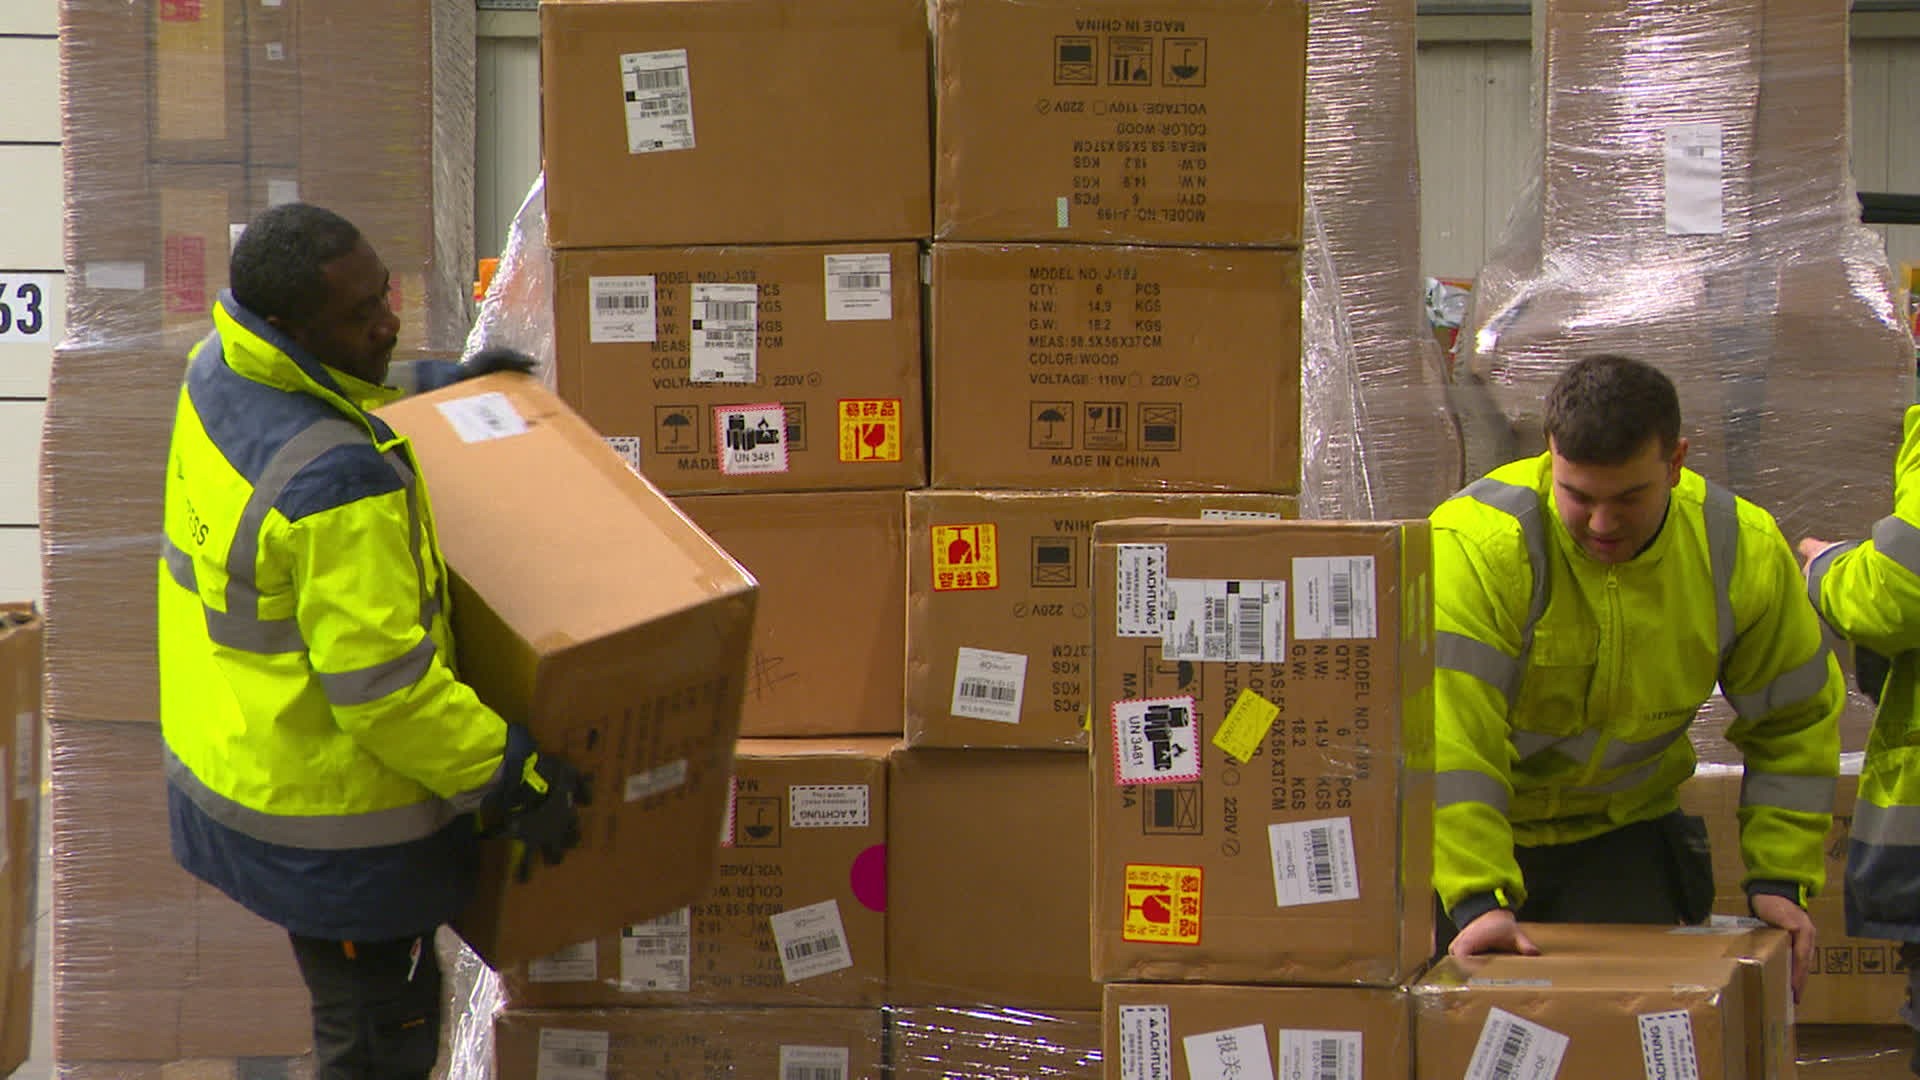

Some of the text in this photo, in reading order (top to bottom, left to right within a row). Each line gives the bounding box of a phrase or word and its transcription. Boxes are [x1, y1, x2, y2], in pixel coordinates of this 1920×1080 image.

[1076, 20, 1185, 32] MADE IN CHINA
[1073, 157, 1100, 168] KGS
[1073, 176, 1100, 188] KGS
[1074, 193, 1100, 205] PCS
[1162, 208, 1206, 222] MODEL
[1029, 267, 1073, 280] MODEL
[1095, 283, 1103, 295] 6
[1135, 283, 1161, 296] PCS
[1135, 300, 1161, 313] KGS
[1135, 320, 1161, 332] KGS
[774, 375, 804, 387] 220V
[1029, 373, 1094, 386] VOLTAGE:
[1151, 374, 1181, 387] 220V
[734, 451, 776, 463] UN 3481
[1051, 455, 1161, 468] MADE IN CHINA
[1146, 569, 1157, 625] ACHTUNG
[1031, 604, 1064, 616] 220V
[1051, 662, 1081, 674] KGS
[1355, 645, 1370, 700] MODEL
[1051, 682, 1081, 695] KGS
[1053, 700, 1081, 713] PCS
[1290, 644, 1306, 811] G.W: 18.2 KGS
[1314, 644, 1330, 810] N.W: 14.9 KGS
[1336, 645, 1352, 809] QTY: 6 PCS
[1129, 716, 1144, 767] UN 3481
[799, 809, 848, 820] ACHTUNG
[1223, 797, 1238, 834] 220V
[1150, 1030, 1161, 1080] ACHTUN
